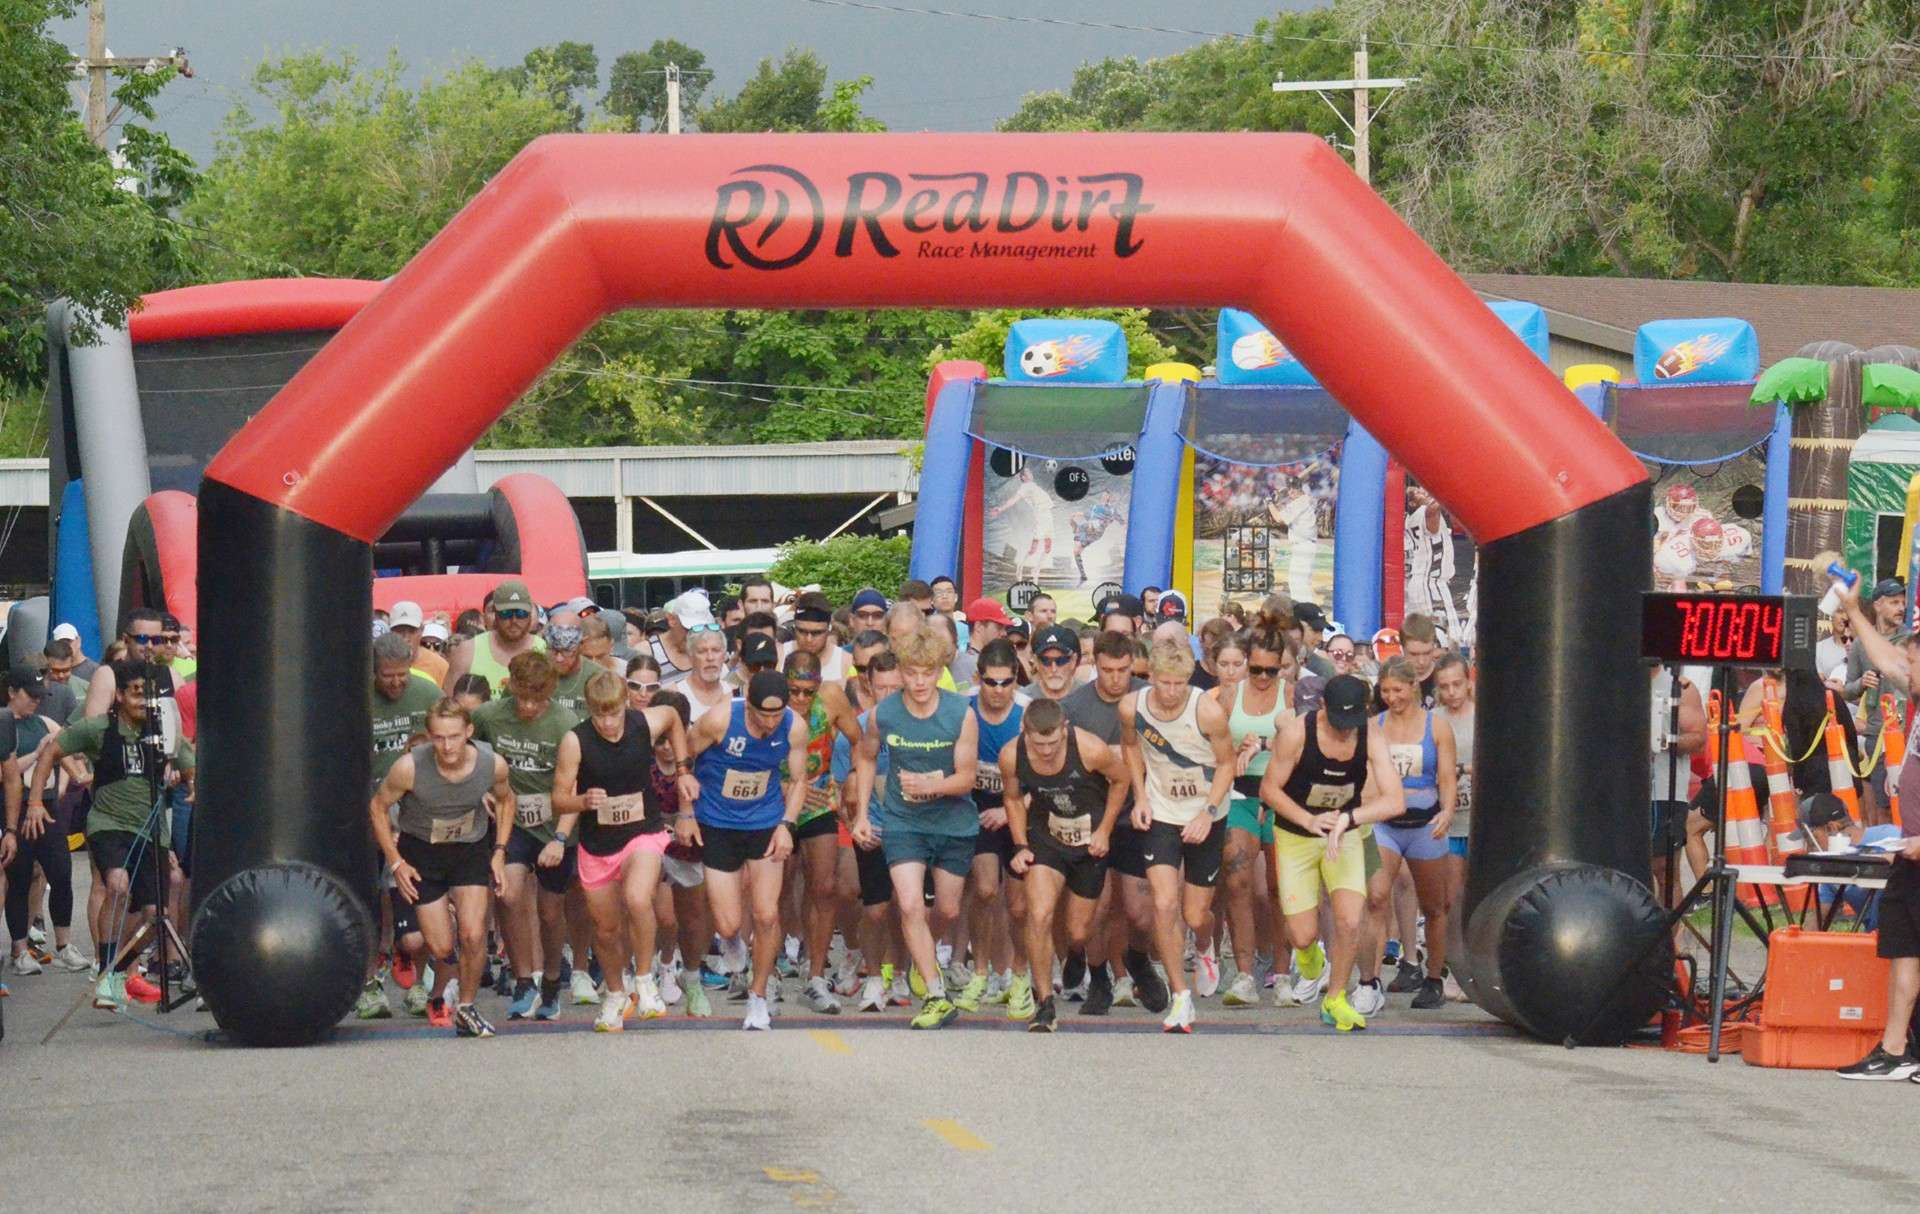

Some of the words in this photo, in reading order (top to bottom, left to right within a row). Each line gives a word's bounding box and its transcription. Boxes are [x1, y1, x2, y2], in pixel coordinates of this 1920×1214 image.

[918, 240, 964, 259] Race
[970, 241, 1097, 261] Management
[732, 784, 759, 798] 664
[1170, 784, 1198, 798] 440
[1320, 796, 1338, 807] 21
[612, 809, 630, 822] 80
